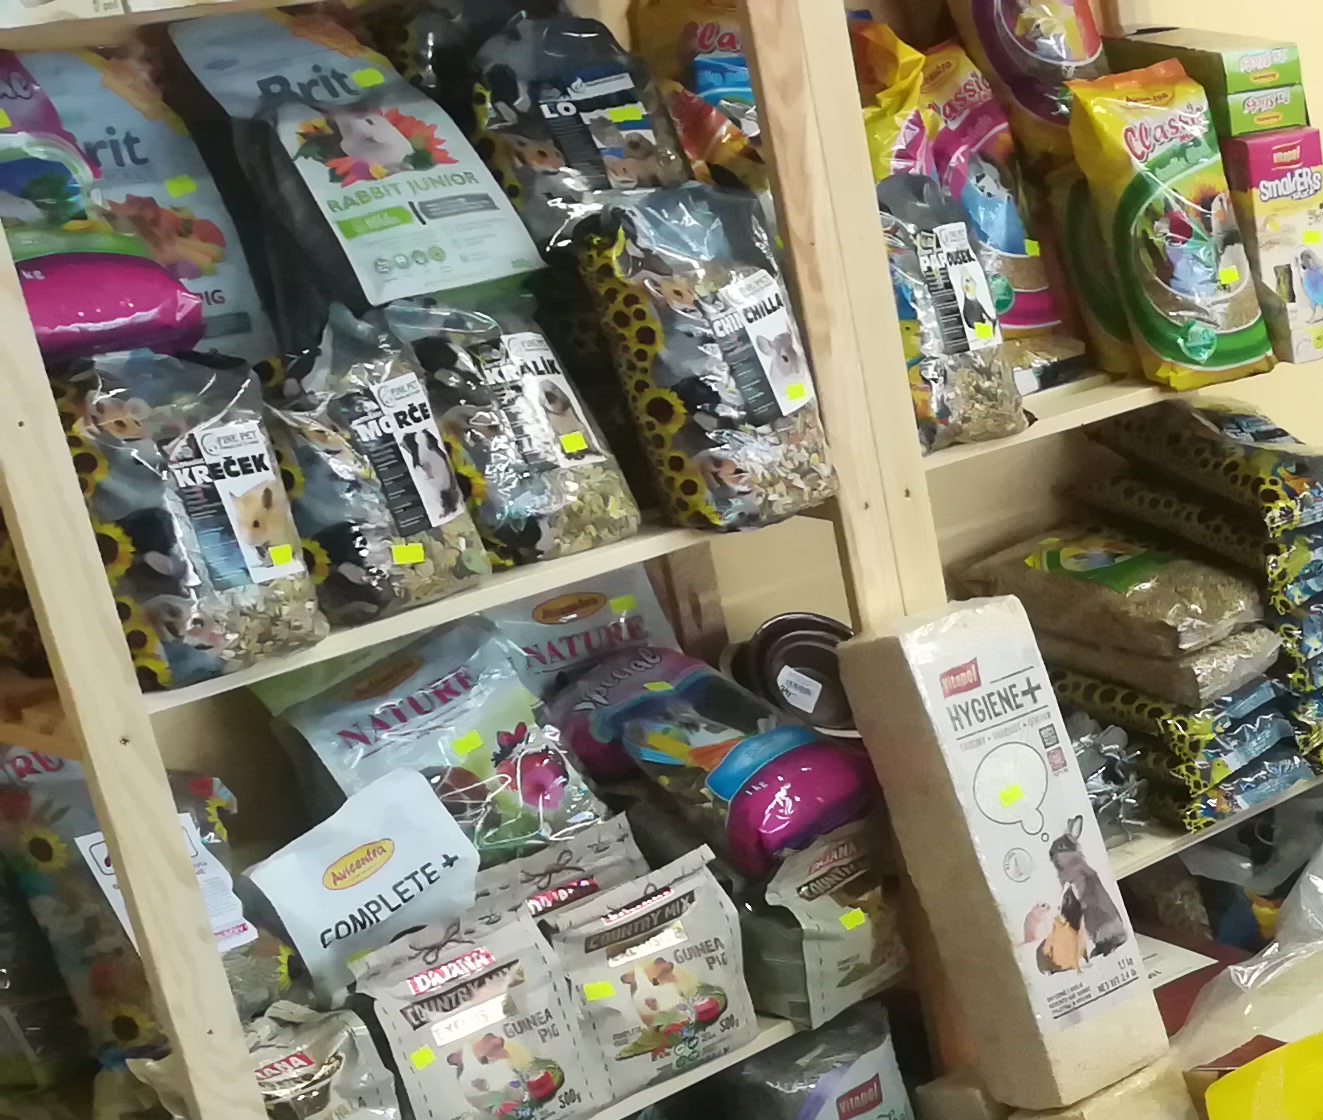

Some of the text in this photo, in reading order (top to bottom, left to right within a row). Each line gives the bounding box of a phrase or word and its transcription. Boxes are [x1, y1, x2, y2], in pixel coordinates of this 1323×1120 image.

[82, 126, 150, 168] rit
[327, 182, 402, 213] RABBIT
[409, 170, 478, 195] JUNIOR
[174, 451, 270, 488] KREČEK
[674, 938, 724, 965] GUINEA
[503, 1008, 553, 1039] GUINEA
[538, 1025, 560, 1044] PIG
